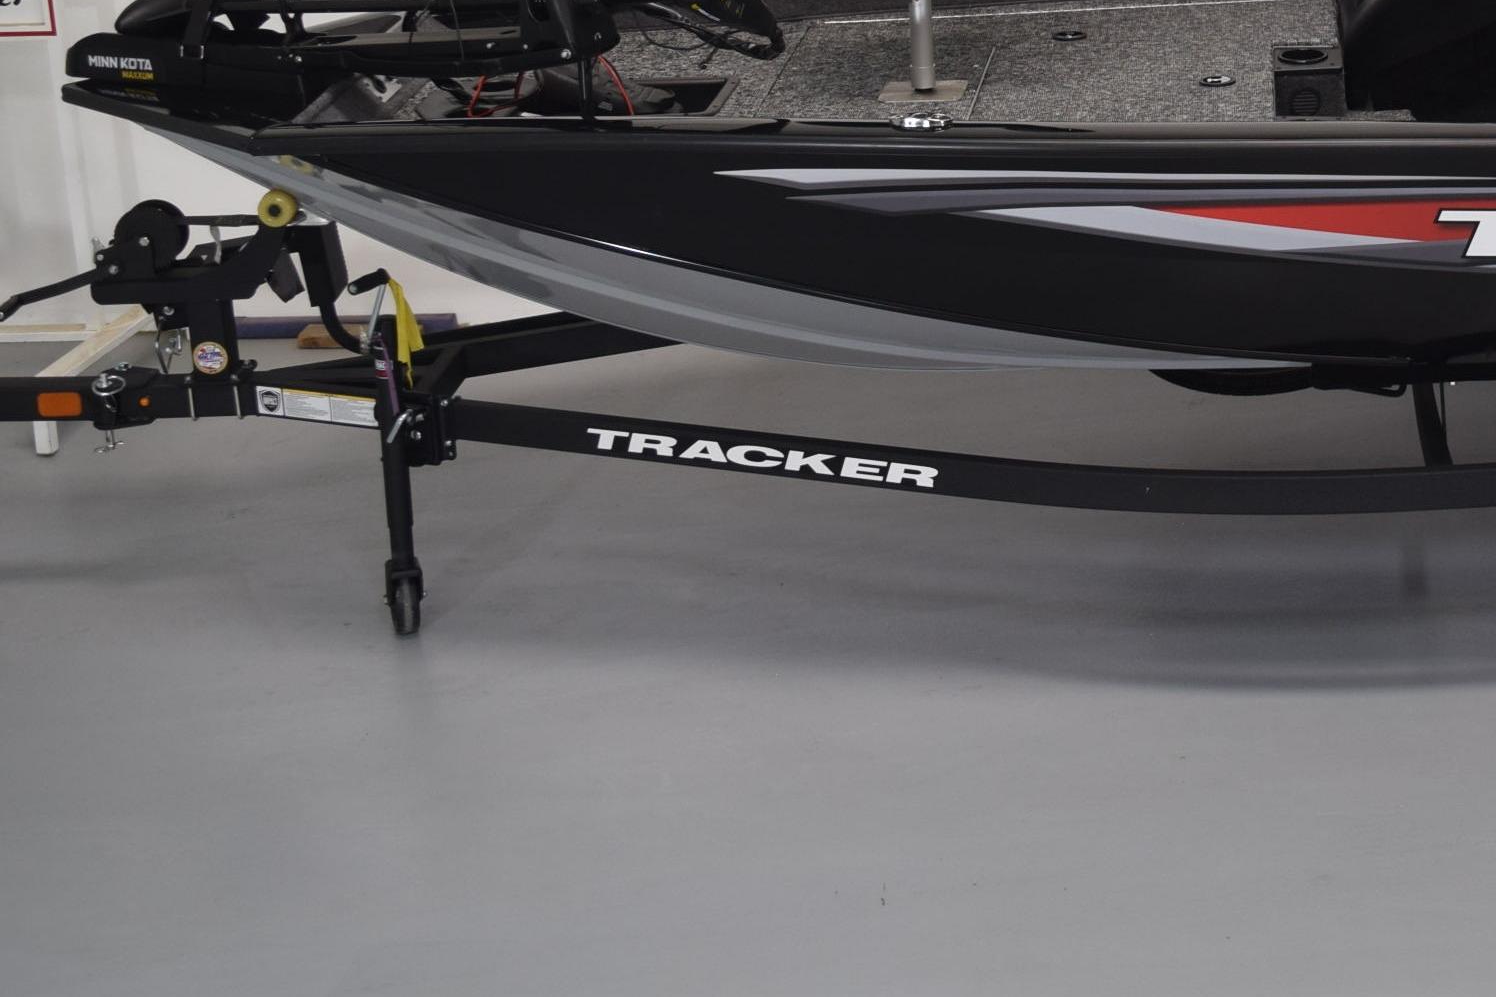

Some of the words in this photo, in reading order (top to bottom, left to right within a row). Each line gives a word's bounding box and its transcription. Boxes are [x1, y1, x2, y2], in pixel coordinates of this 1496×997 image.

[87, 55, 118, 69] MINN
[120, 57, 153, 71] KOTA
[586, 427, 939, 488] TRACKER
